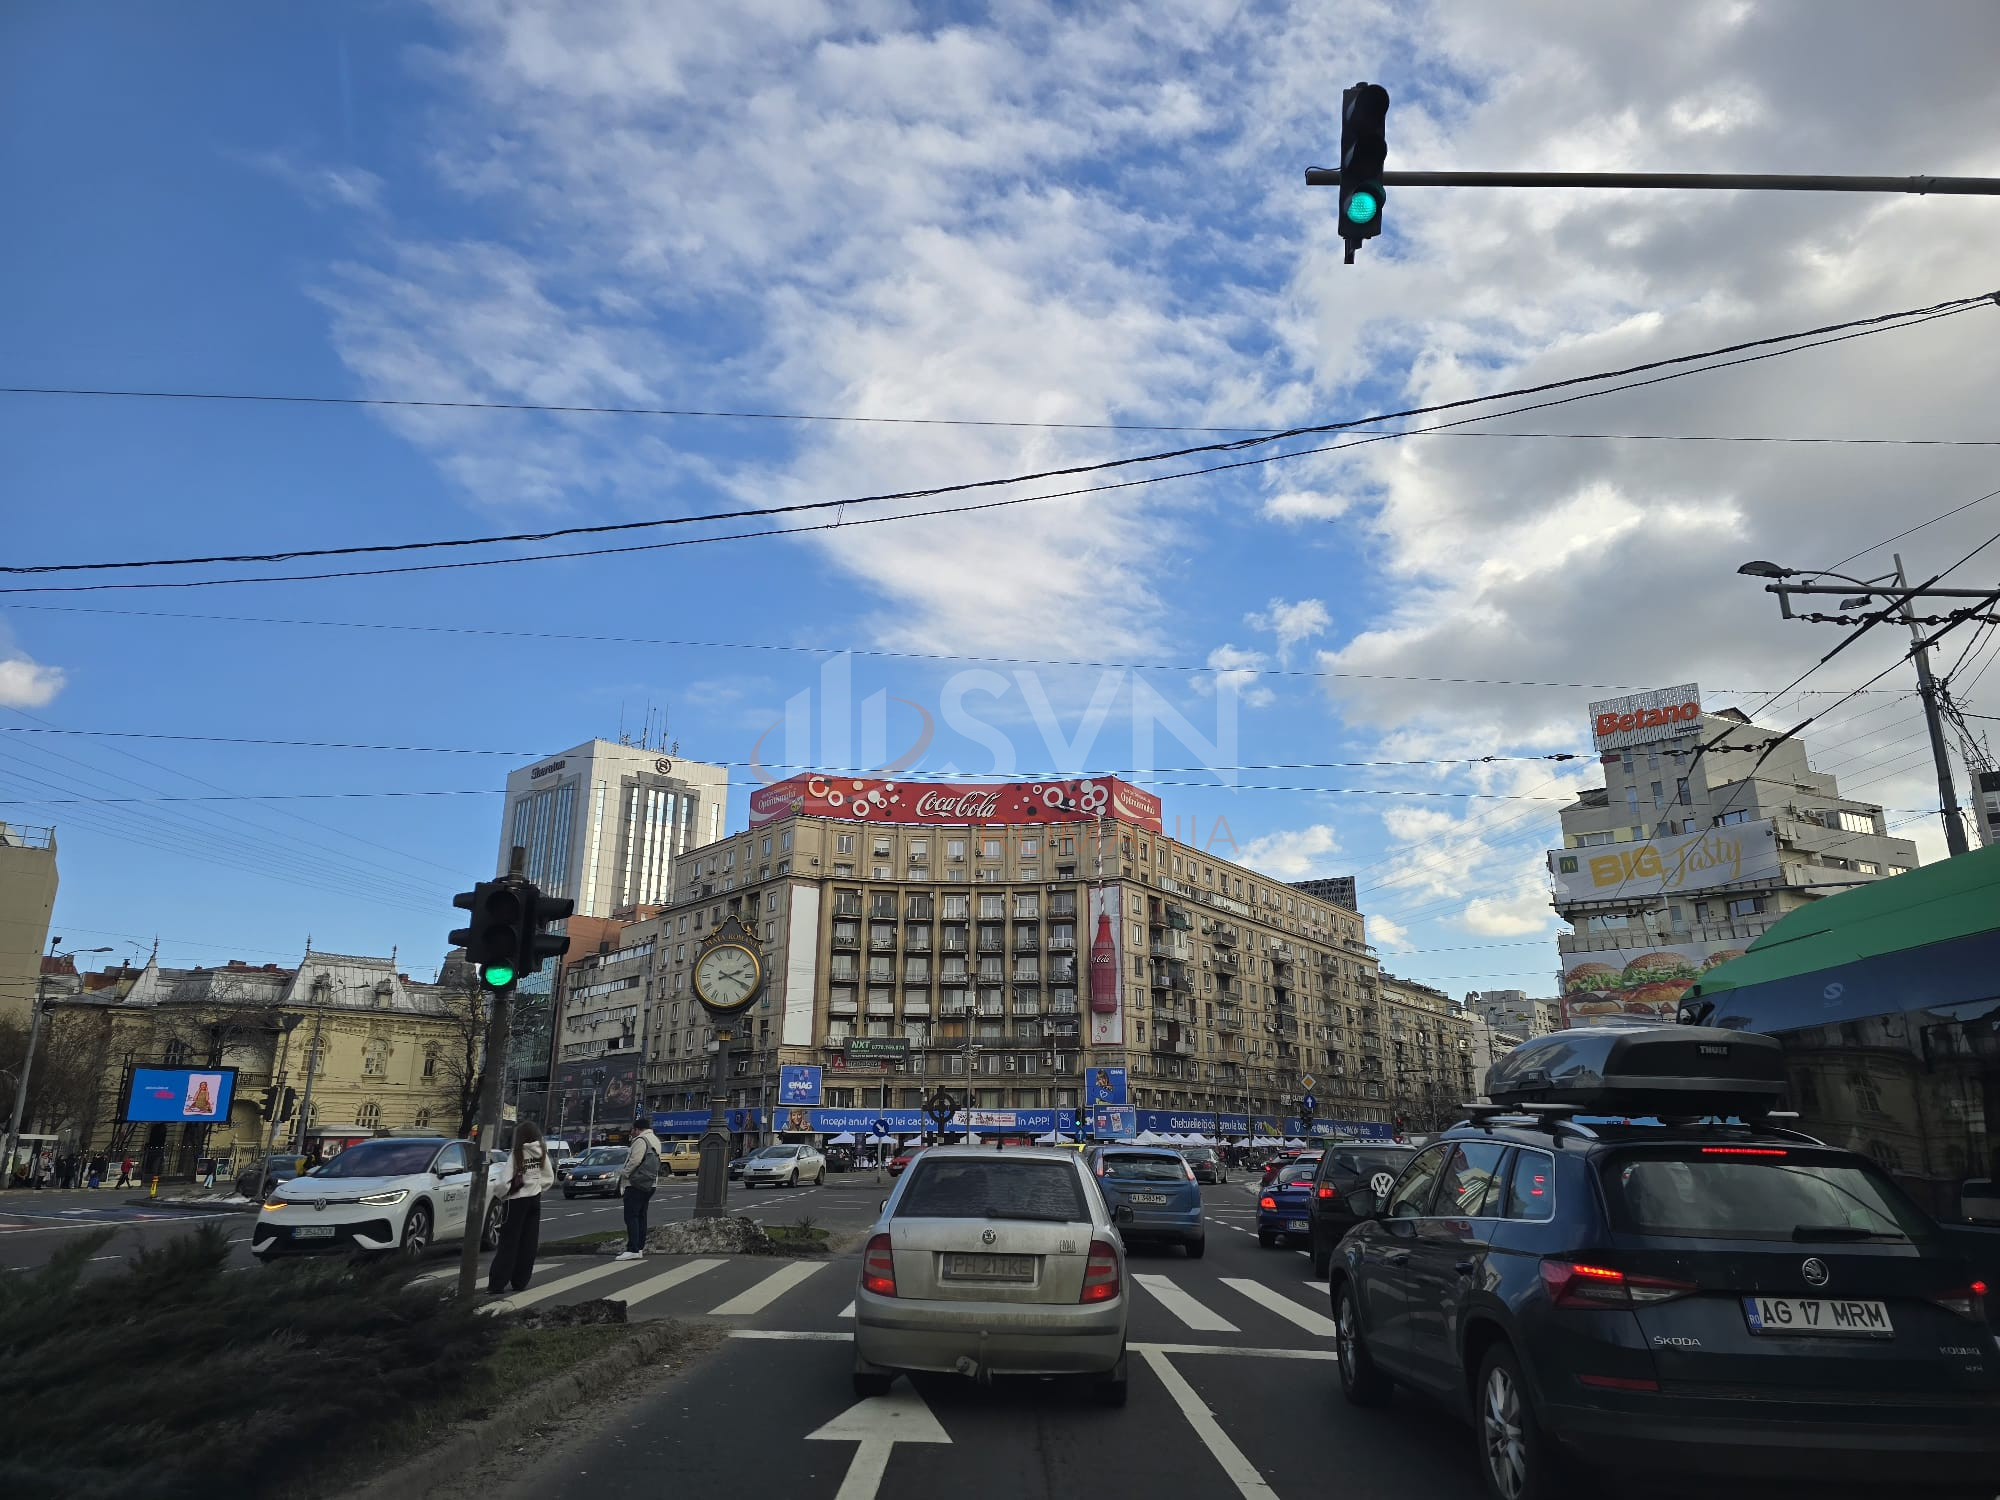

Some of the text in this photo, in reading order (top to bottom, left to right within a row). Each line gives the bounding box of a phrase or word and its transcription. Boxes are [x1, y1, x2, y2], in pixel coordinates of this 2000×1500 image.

[1597, 702, 1699, 736] Betano
[915, 790, 1004, 818] Coca-Cola
[1588, 834, 1742, 888] BIG Tasty
[788, 1081, 813, 1090] eMAG
[954, 1255, 976, 1273] PH
[1763, 1300, 1886, 1328] AG 17 MRM
